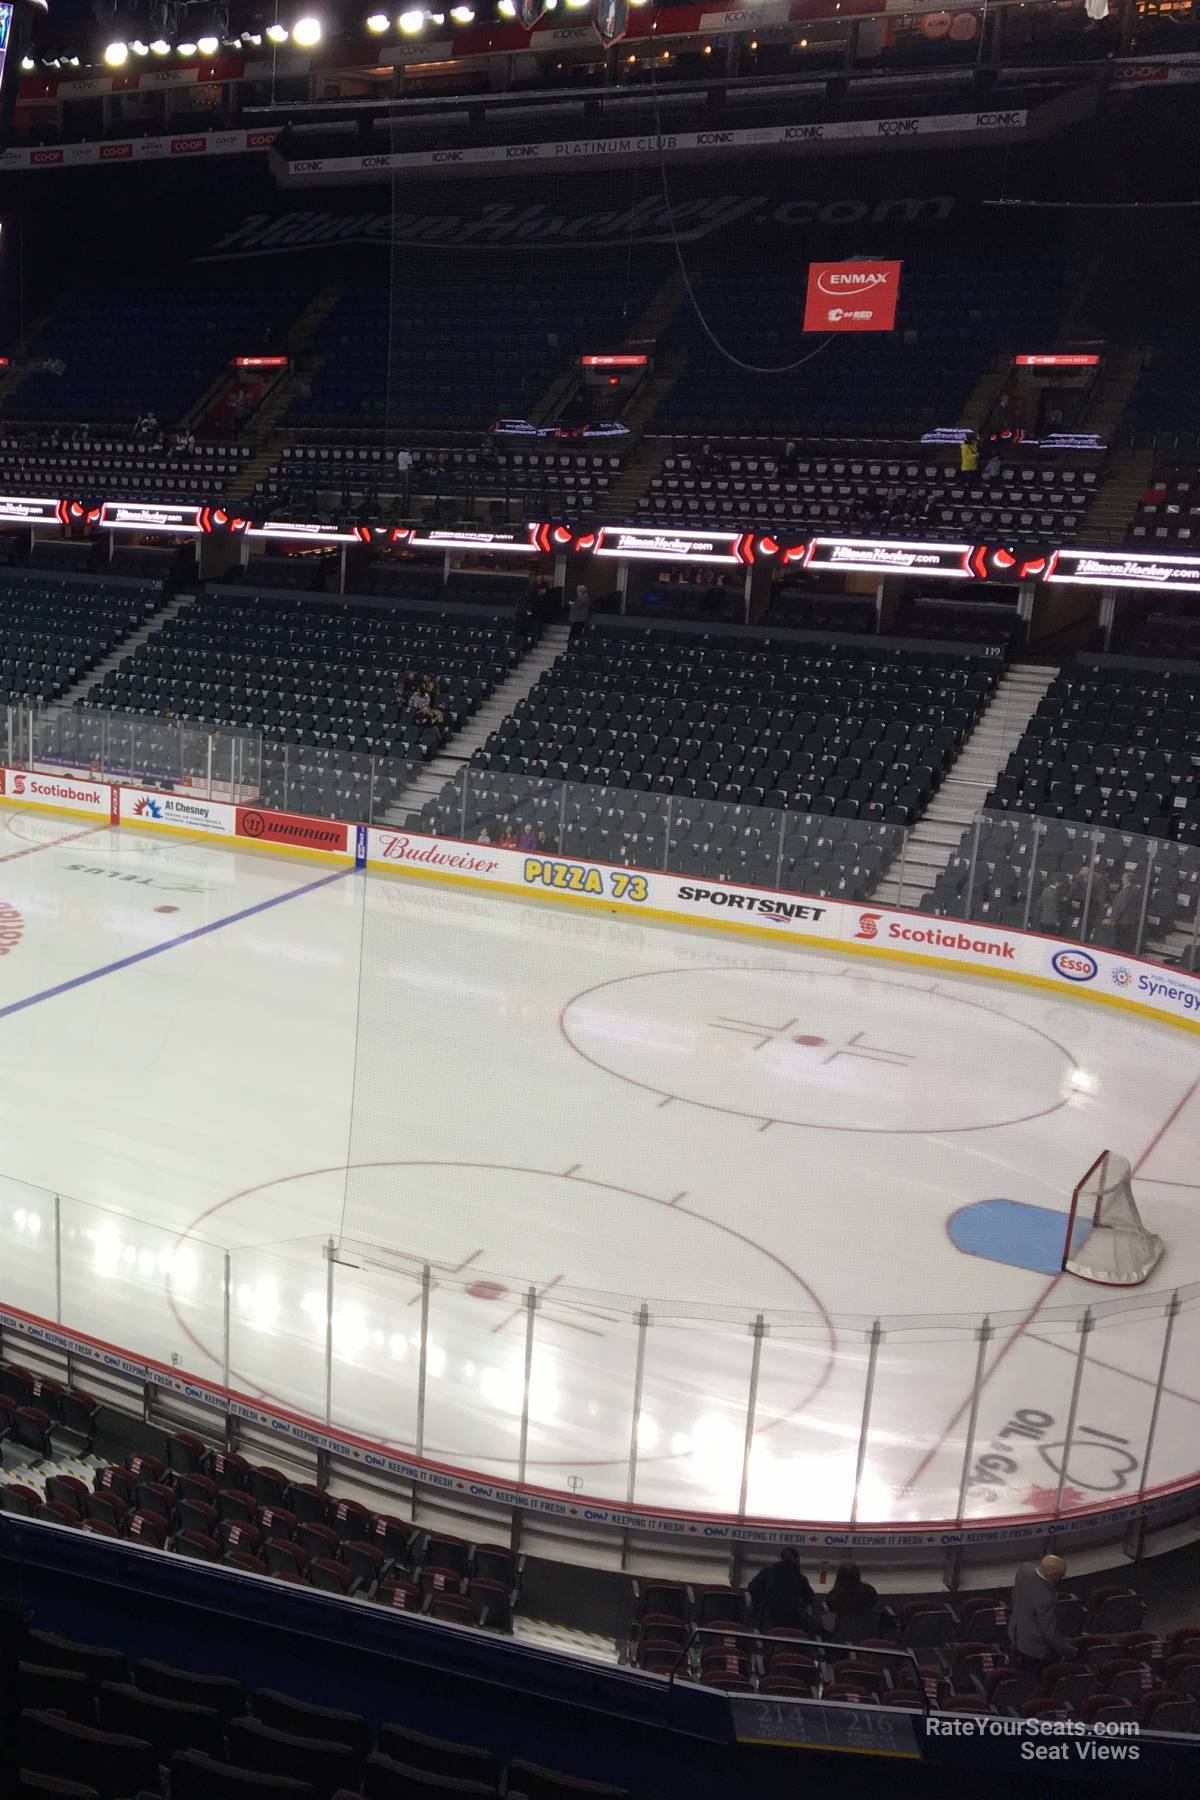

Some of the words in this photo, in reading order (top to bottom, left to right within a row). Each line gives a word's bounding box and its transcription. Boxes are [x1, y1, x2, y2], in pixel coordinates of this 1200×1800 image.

[878, 120, 919, 132] ICONIC
[976, 113, 1020, 126] ICONIC
[697, 133, 734, 144] ICONIC
[785, 127, 824, 138] ICONIC
[103, 146, 130, 157] CO-OP
[175, 140, 203, 152] CO-OP
[506, 146, 539, 156] ICONIC
[555, 140, 631, 155] PLATINUM
[636, 137, 677, 150] CLUB
[294, 162, 323, 171] ICONIC
[432, 152, 464, 162] ICONIC
[830, 273, 887, 285] ENMAX
[617, 534, 713, 554] HitmenHockey.com
[831, 545, 940, 566] HitmenHockey.com
[1074, 559, 1200, 581] HitmenHockey.com
[985, 647, 1001, 656] 119
[30, 781, 101, 804] Scotiabank
[175, 801, 210, 819] Chesney
[266, 821, 341, 844] WARRIOR
[378, 834, 499, 873] Budweiser
[65, 864, 154, 885] TELUS
[523, 858, 603, 895] PIZZA
[609, 872, 649, 902] 73
[677, 886, 827, 922] SPORTSNET
[888, 922, 1017, 960] Scotiabank
[1058, 955, 1093, 975] Esso
[997, 1408, 1055, 1441] OIL
[292, 1425, 320, 1443] KEEPING
[320, 1435, 327, 1445] IT
[328, 1438, 350, 1455] FRESH
[388, 1461, 419, 1478] KEEPING
[419, 1471, 428, 1481] IT
[429, 1473, 453, 1488] FRESH
[495, 1491, 529, 1507] KEEPING
[530, 1499, 538, 1508] IT
[540, 1501, 566, 1515] FRESH
[611, 1514, 647, 1528] KEEPING
[648, 1519, 657, 1529] IT
[658, 1521, 685, 1532] FRESH
[732, 1529, 767, 1541] KEEPING
[768, 1533, 777, 1542] IT
[779, 1534, 806, 1544] FRESH
[852, 1536, 886, 1545] KEEPING
[887, 1536, 896, 1544] IT
[897, 1535, 924, 1545] FRESH
[758, 1703, 805, 1724] 214
[846, 1711, 894, 1734] 216
